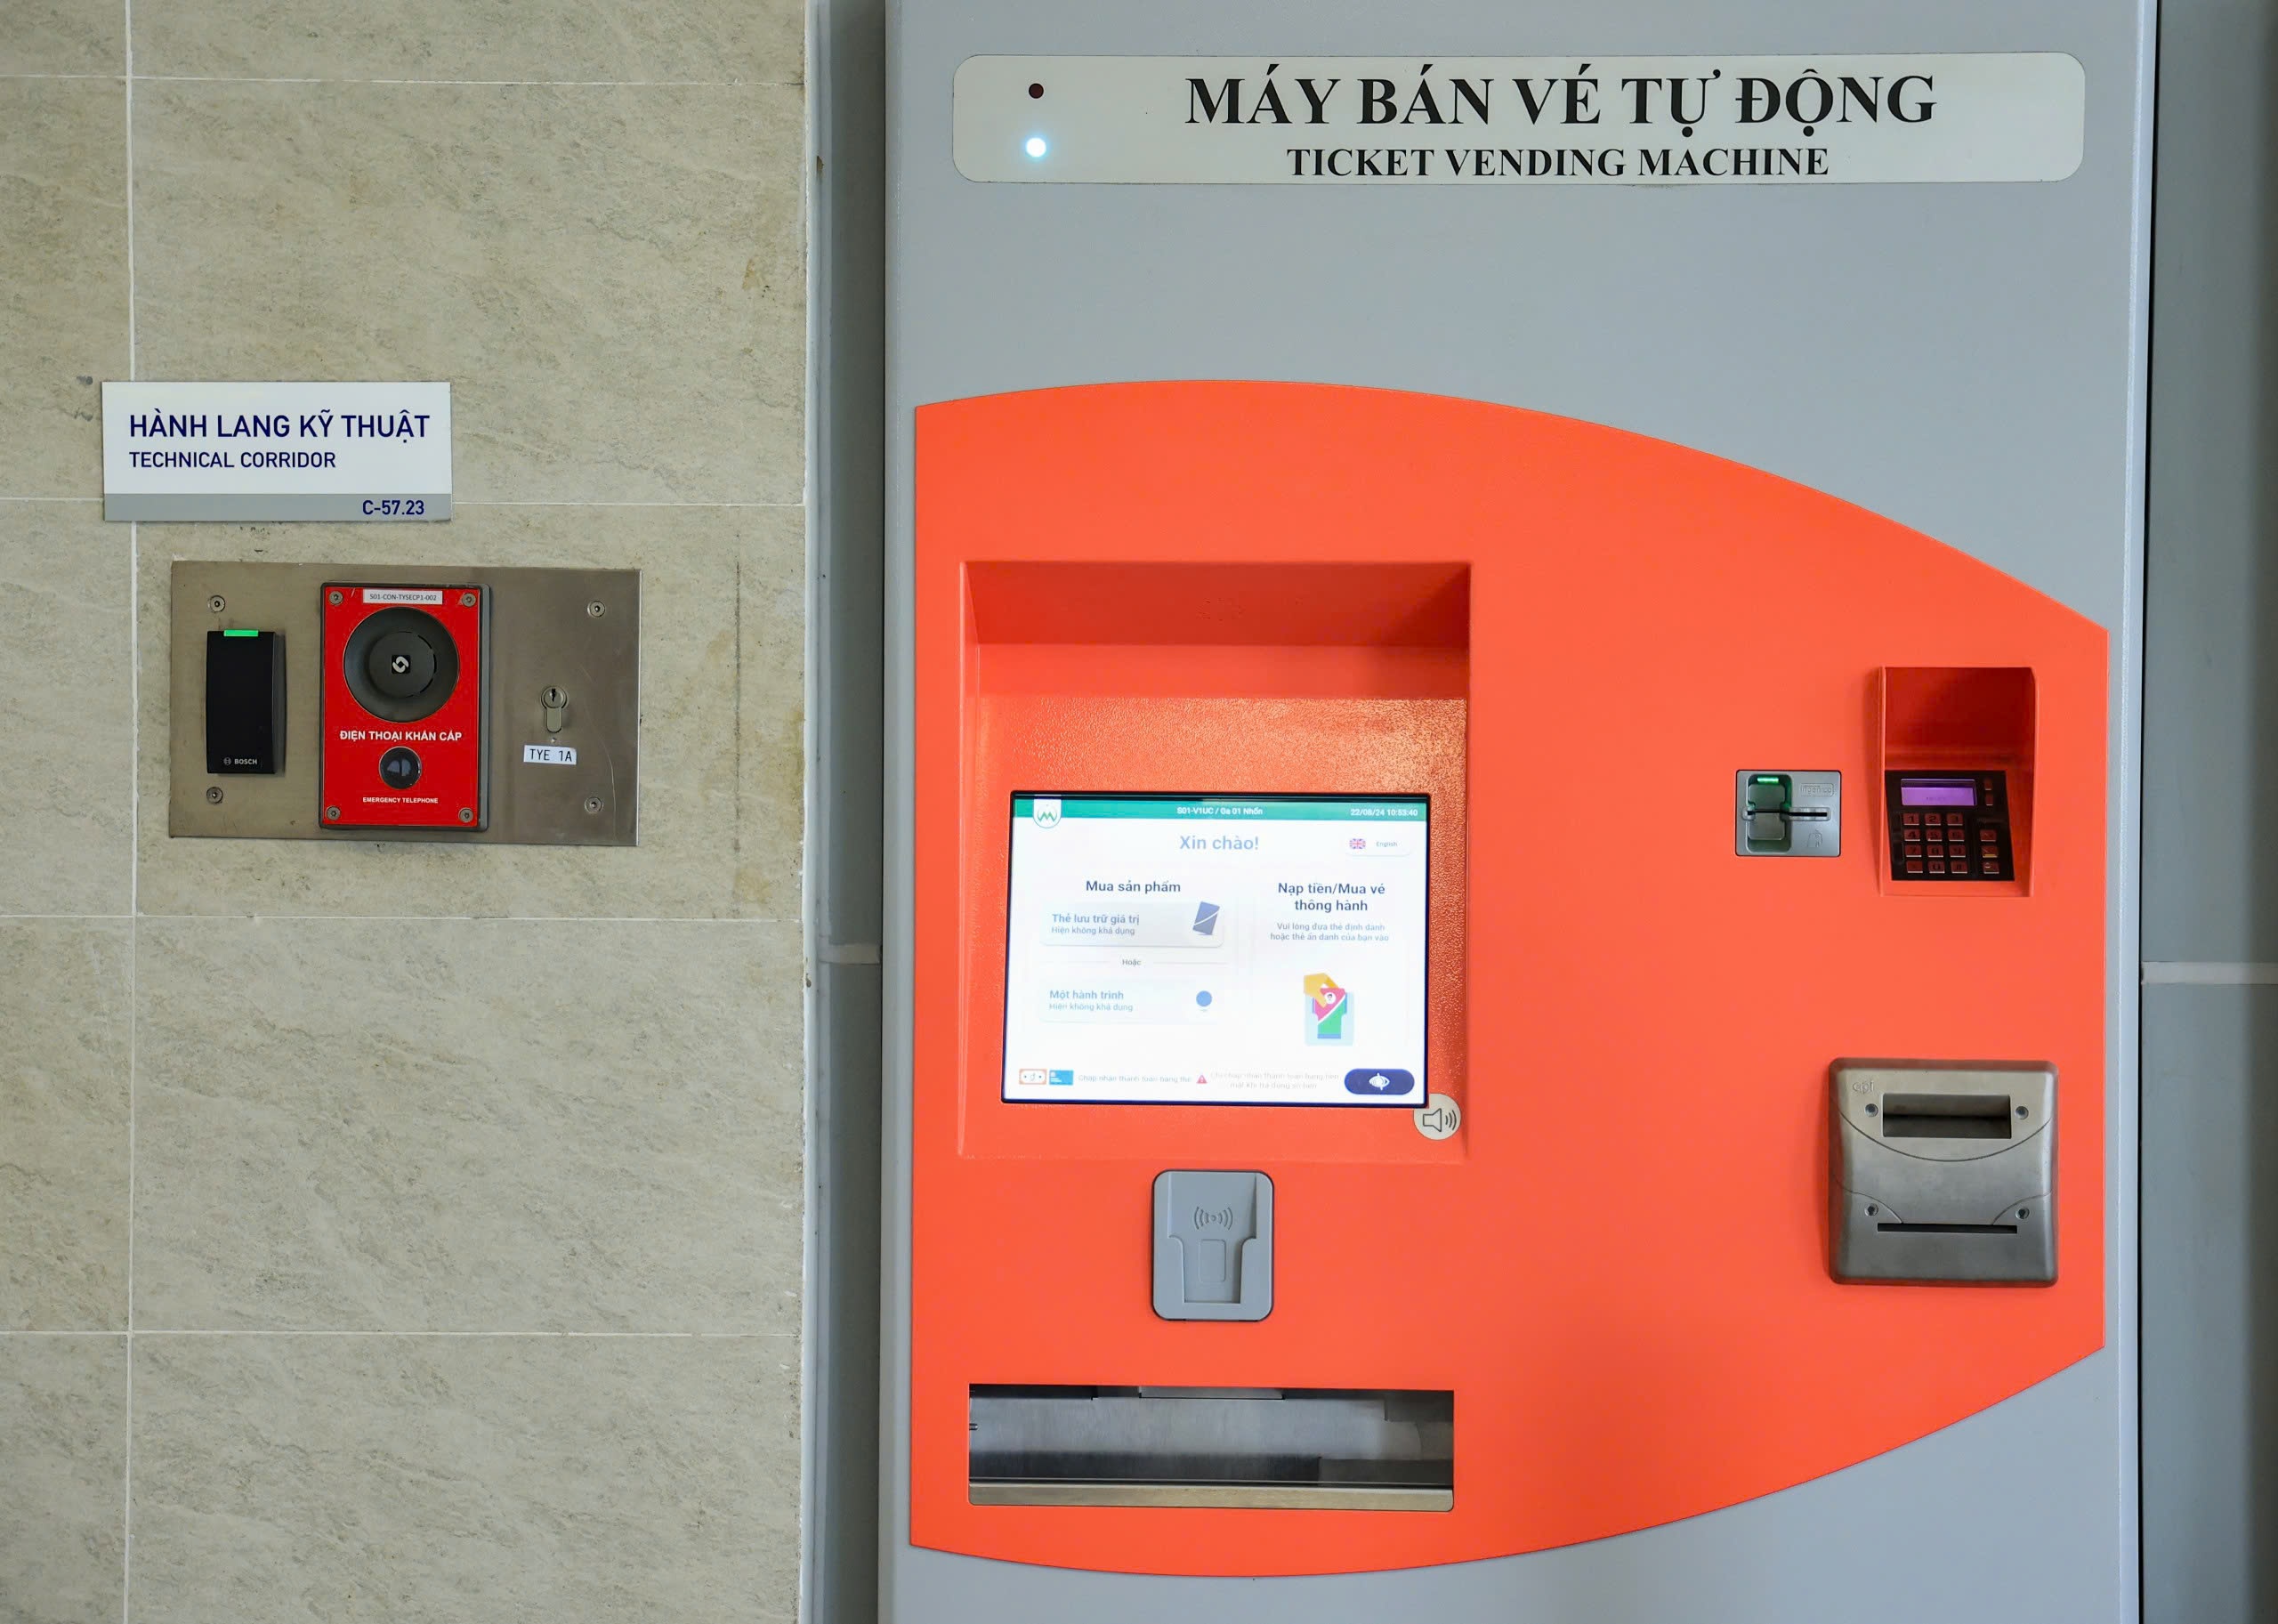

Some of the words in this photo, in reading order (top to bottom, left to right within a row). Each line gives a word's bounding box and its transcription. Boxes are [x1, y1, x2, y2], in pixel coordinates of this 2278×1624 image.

[1185, 64, 1341, 124] MÁY
[1357, 64, 1495, 125] BÁN
[1510, 63, 1601, 125] VÉ
[1621, 69, 1721, 138] TỰ
[1735, 69, 1937, 138] ĐỘNG
[1287, 148, 1435, 176] TICKET
[1445, 149, 1626, 177] VENDING
[1637, 148, 1830, 176] MACHINE
[130, 408, 206, 438] HÀNH
[217, 415, 290, 438] LANG
[300, 408, 334, 437] KỸ
[341, 409, 431, 443] THUẬT
[129, 452, 234, 468] TECHNICAL
[240, 452, 335, 468] CORRIDOR
[362, 499, 424, 515] C-57.23
[368, 731, 402, 742] THOẠI
[529, 748, 550, 761] TYE
[559, 750, 572, 762] 1A
[1220, 807, 1231, 815] Ga
[1232, 807, 1241, 815] 01
[1180, 835, 1207, 849] Xin
[1212, 835, 1259, 851] chào!
[1376, 840, 1398, 848] English
[1086, 880, 1113, 892] Mua
[1118, 879, 1141, 892] sản
[1278, 882, 1304, 896] Nạp
[1370, 883, 1385, 894] vé
[1295, 899, 1332, 913] thông
[1336, 900, 1369, 911] hành
[1111, 915, 1126, 925] giá
[1128, 914, 1140, 925] trị
